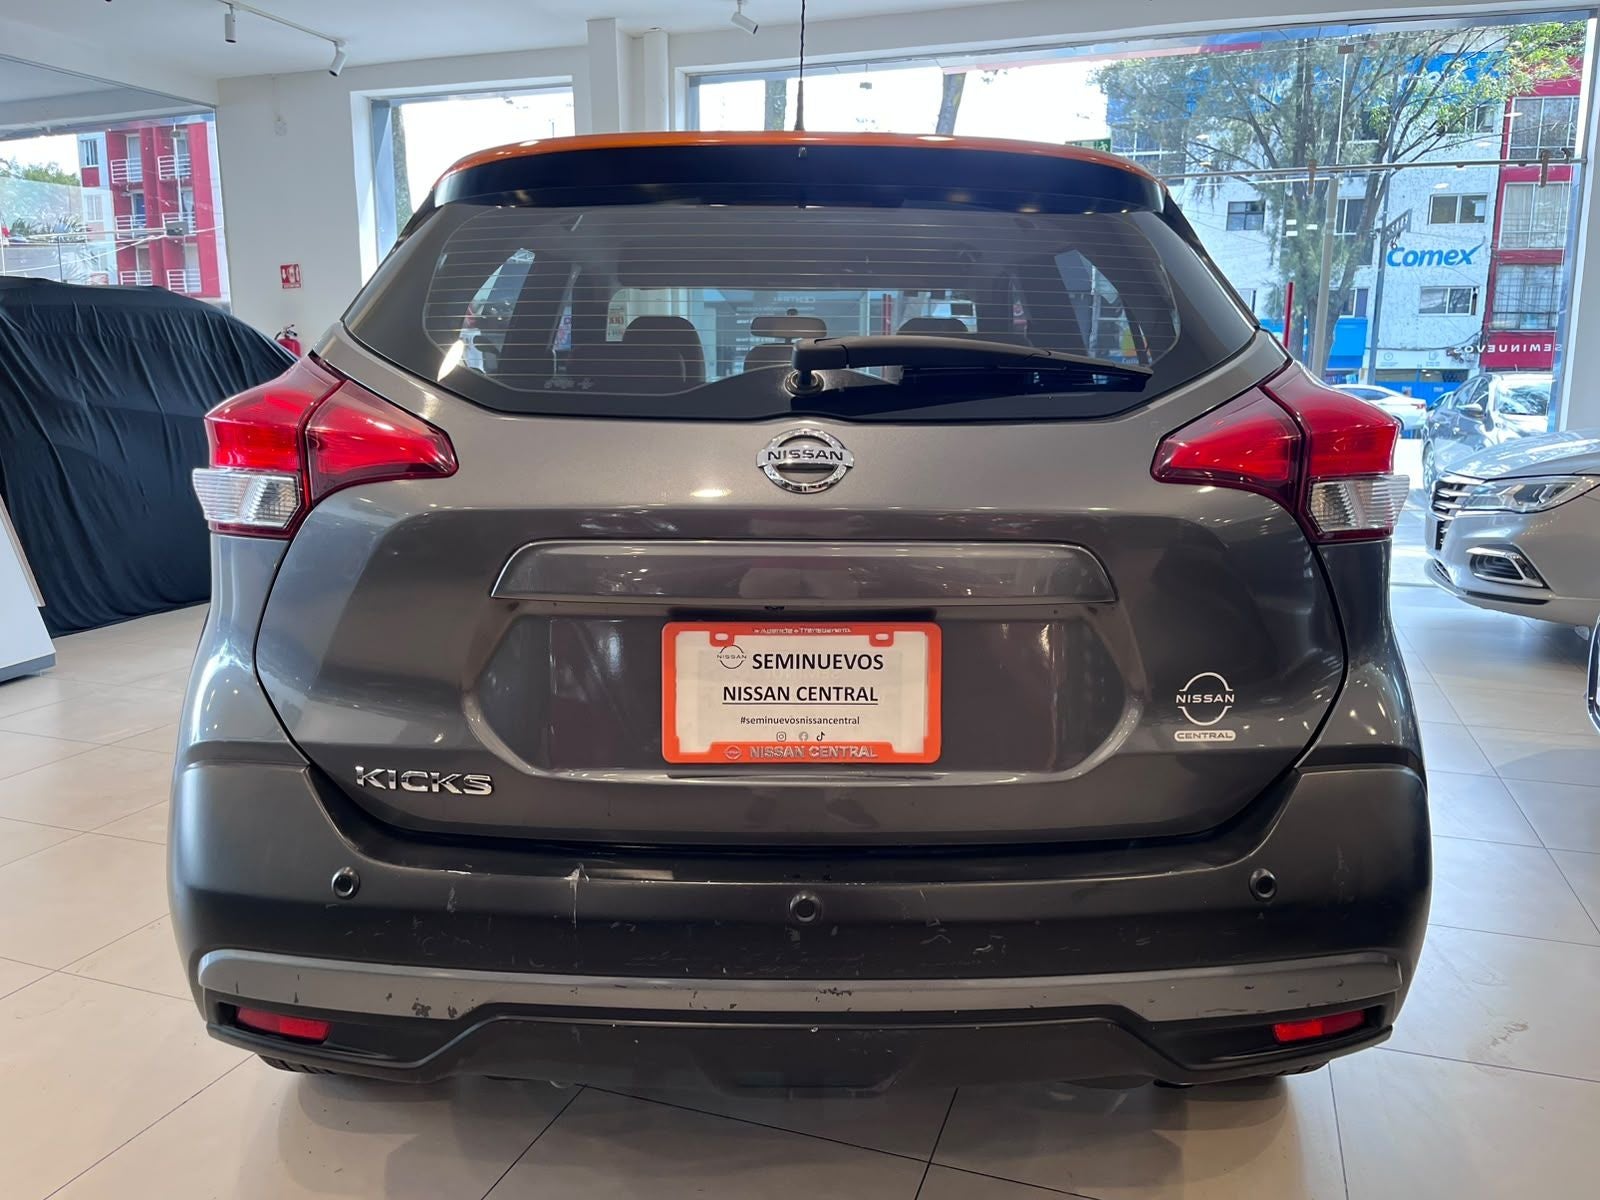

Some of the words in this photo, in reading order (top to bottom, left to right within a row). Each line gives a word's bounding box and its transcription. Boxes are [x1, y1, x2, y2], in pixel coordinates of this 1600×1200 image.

[1387, 242, 1485, 267] Comex
[767, 449, 843, 461] NISSAN
[752, 653, 884, 670] SEMINUEVOS
[723, 686, 790, 702] NISSAN
[796, 686, 879, 702] CENTRAL
[1175, 694, 1235, 703] NISSAN
[740, 716, 860, 726] #seminuevosnissancentral
[1176, 732, 1233, 740] CENTRAL
[750, 745, 805, 759] NISSAN
[808, 745, 879, 758] CENTRAL
[355, 765, 493, 796] KICKS
